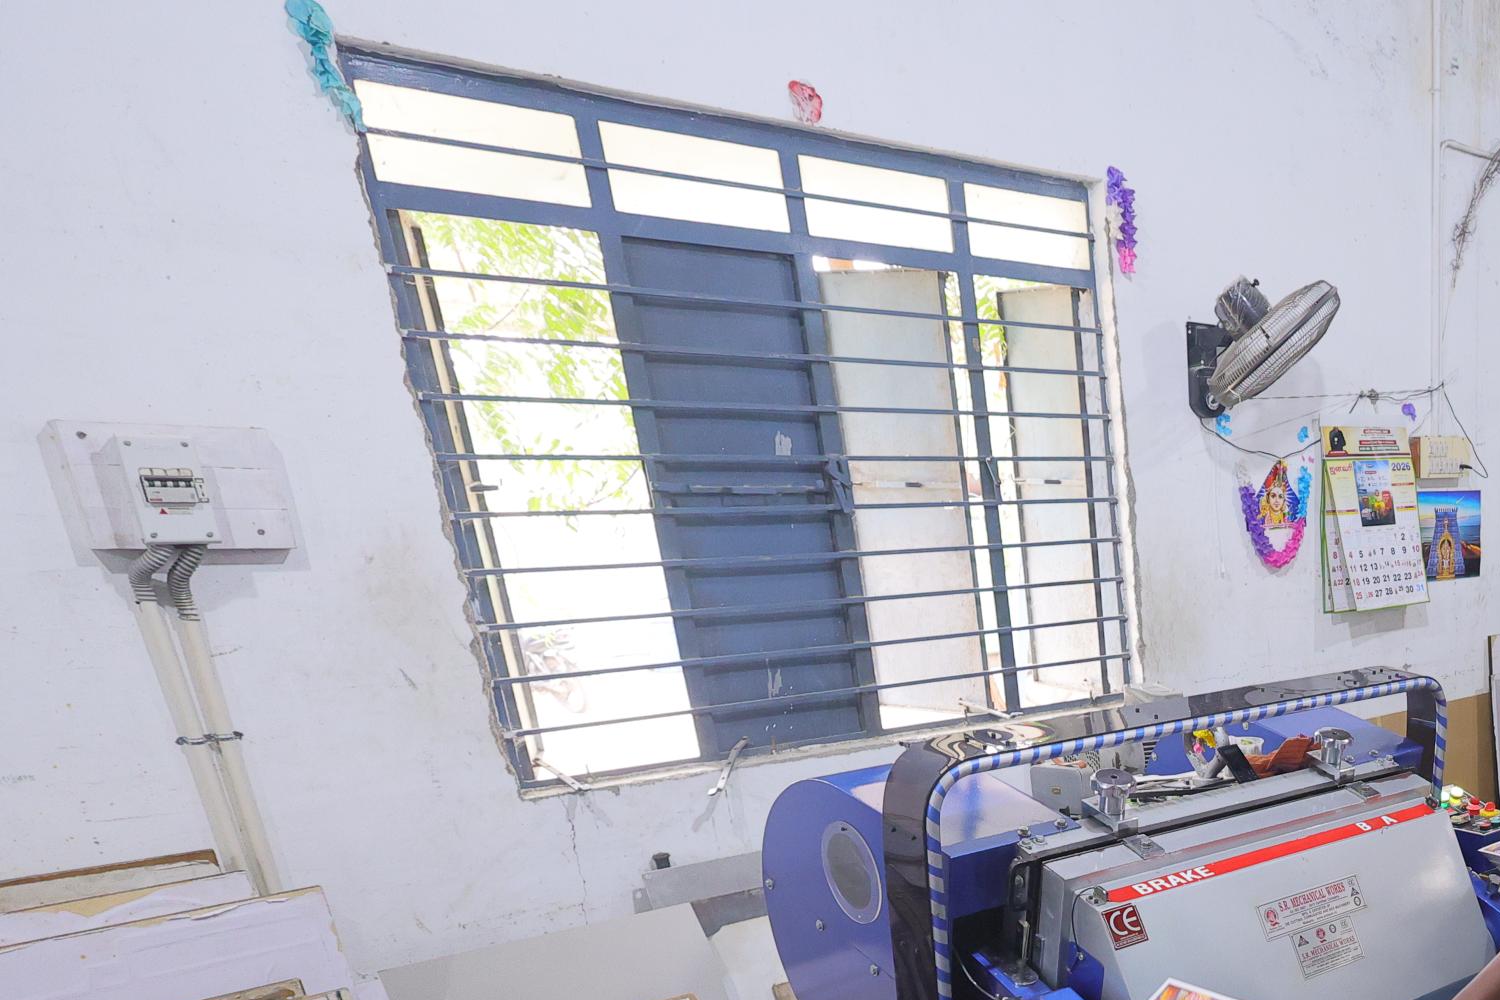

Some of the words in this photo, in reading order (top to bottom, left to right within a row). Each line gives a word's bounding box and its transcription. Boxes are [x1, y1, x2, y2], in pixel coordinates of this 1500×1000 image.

[1391, 462, 1411, 472] 2026
[1400, 532, 1406, 541] 2
[1358, 550, 1364, 559] 5
[1380, 547, 1385, 556] 7
[1390, 547, 1396, 555] 8
[1402, 546, 1407, 554] 9
[1412, 545, 1420, 553] 10
[1359, 563, 1368, 572] 12
[1370, 562, 1378, 571] 13
[1362, 577, 1370, 585] 19
[1372, 575, 1381, 585] 20
[1382, 574, 1390, 583] 21
[1392, 573, 1402, 582] 22
[1404, 572, 1412, 581] 23
[1375, 589, 1383, 598] 27
[1385, 587, 1394, 596] 28
[1405, 585, 1414, 594] 30
[1355, 822, 1372, 831] B
[1380, 815, 1399, 825] A
[1131, 866, 1215, 895] BRAKE
[1290, 887, 1327, 908] MECHANICAL
[1325, 881, 1346, 895] WORKS
[1109, 907, 1141, 936] CE
[1310, 941, 1339, 958] MECHANICAL
[1339, 935, 1356, 946] WORKS
